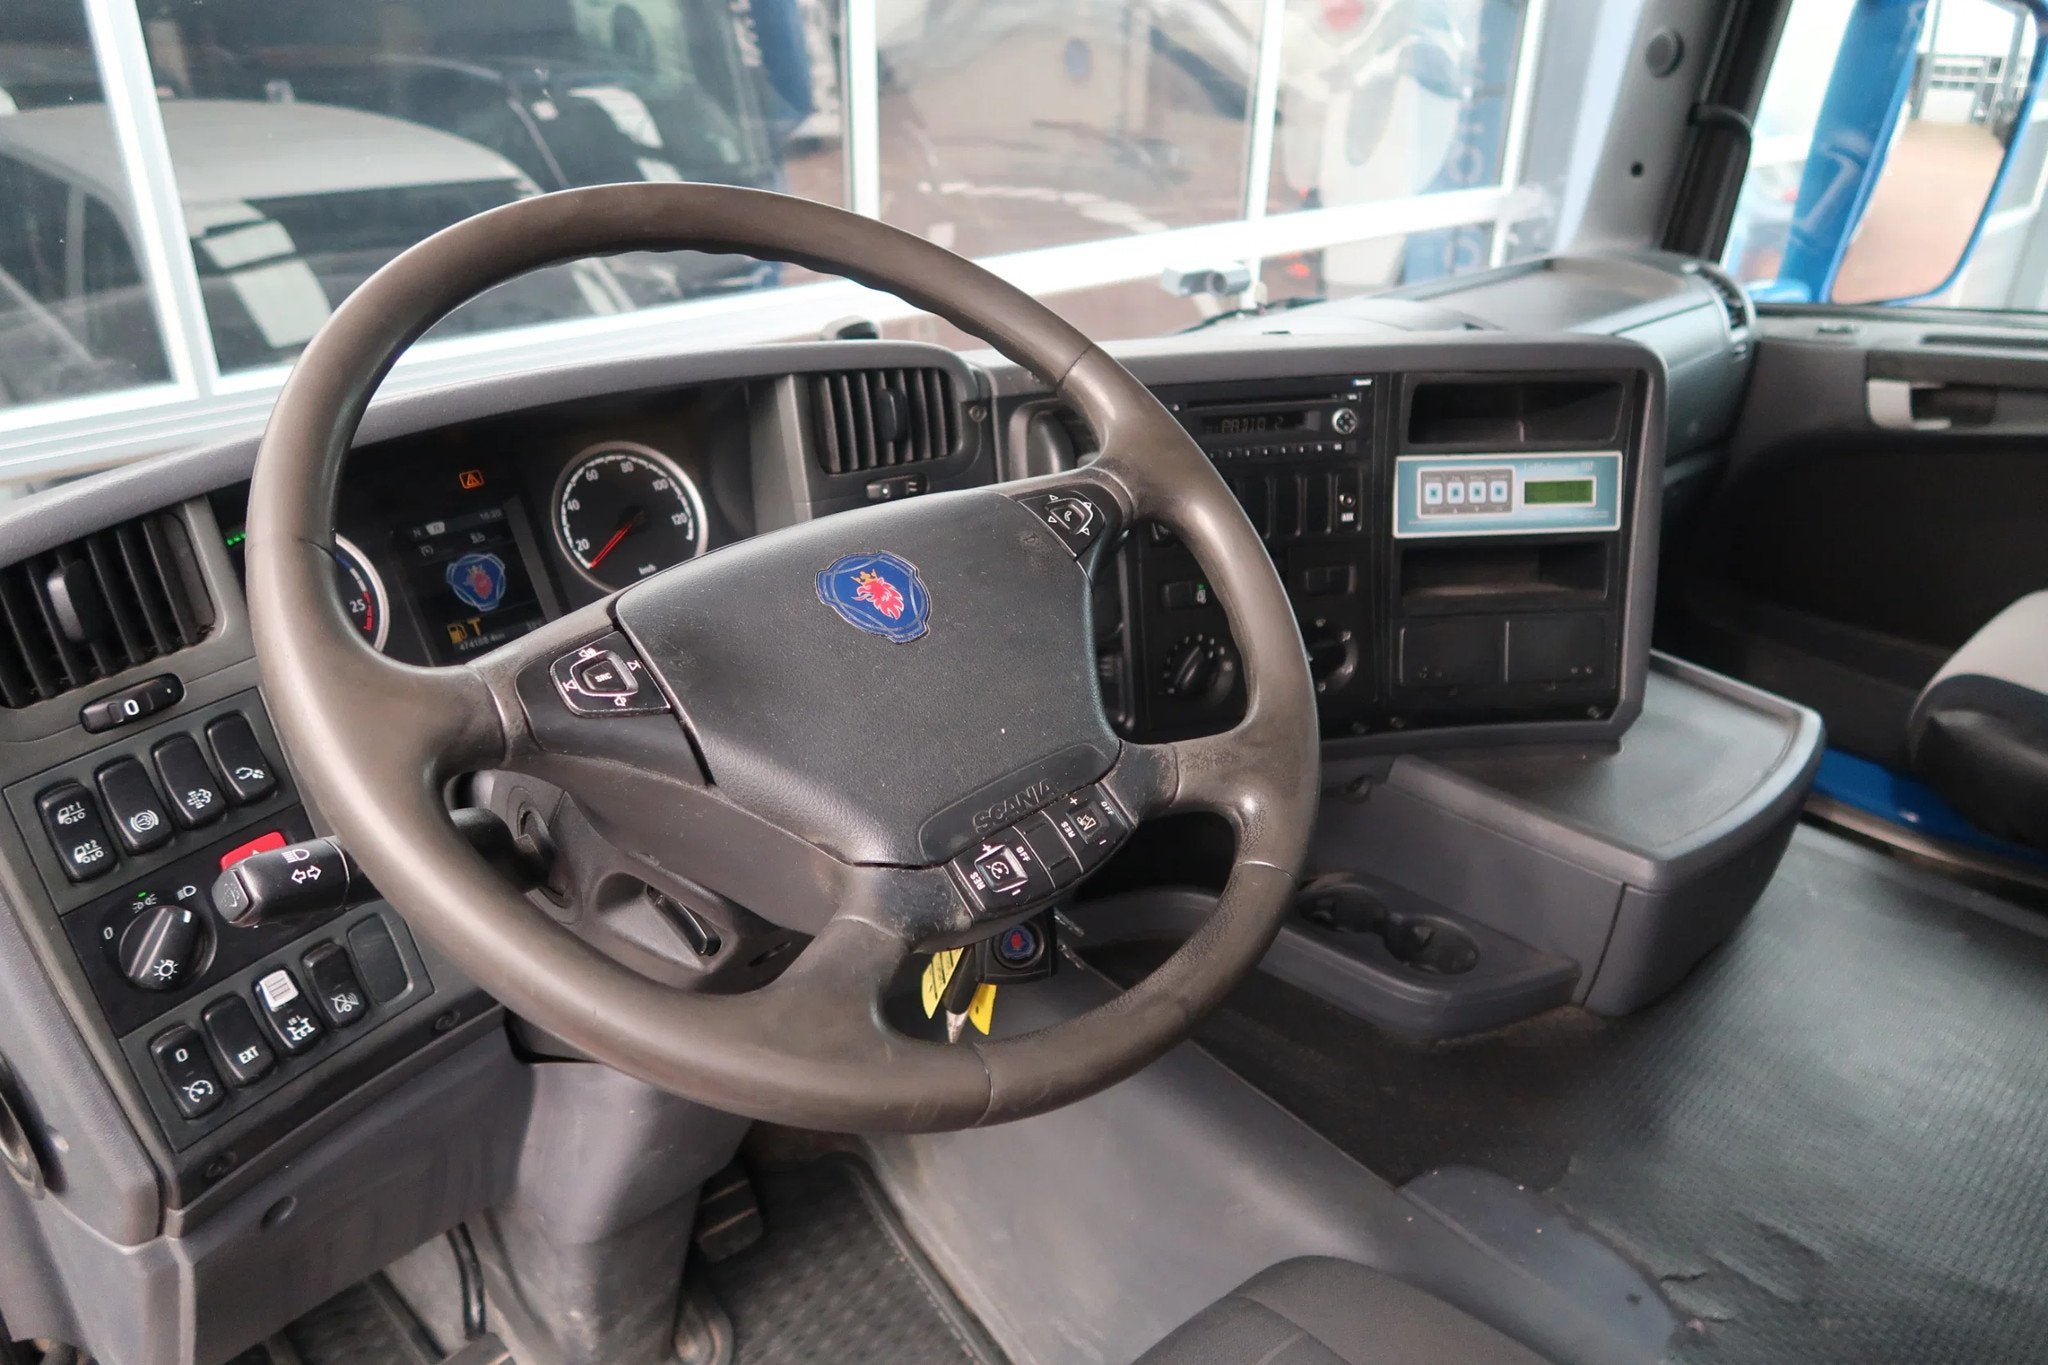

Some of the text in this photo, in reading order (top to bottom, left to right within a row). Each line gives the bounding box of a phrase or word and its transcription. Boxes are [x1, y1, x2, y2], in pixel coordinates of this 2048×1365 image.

[620, 461, 635, 473] 80
[585, 469, 599, 482] 60
[652, 478, 669, 491] 100
[567, 498, 581, 511] 40
[671, 512, 687, 526] 120
[575, 538, 591, 552] 20
[349, 598, 367, 613] 25
[594, 671, 613, 683] SRC
[973, 781, 1058, 834] SCANIA
[1101, 800, 1116, 817] OFF
[1060, 820, 1076, 839] RES
[1016, 845, 1032, 863] OFF
[968, 871, 986, 892] RES
[238, 1045, 260, 1065] EXT
